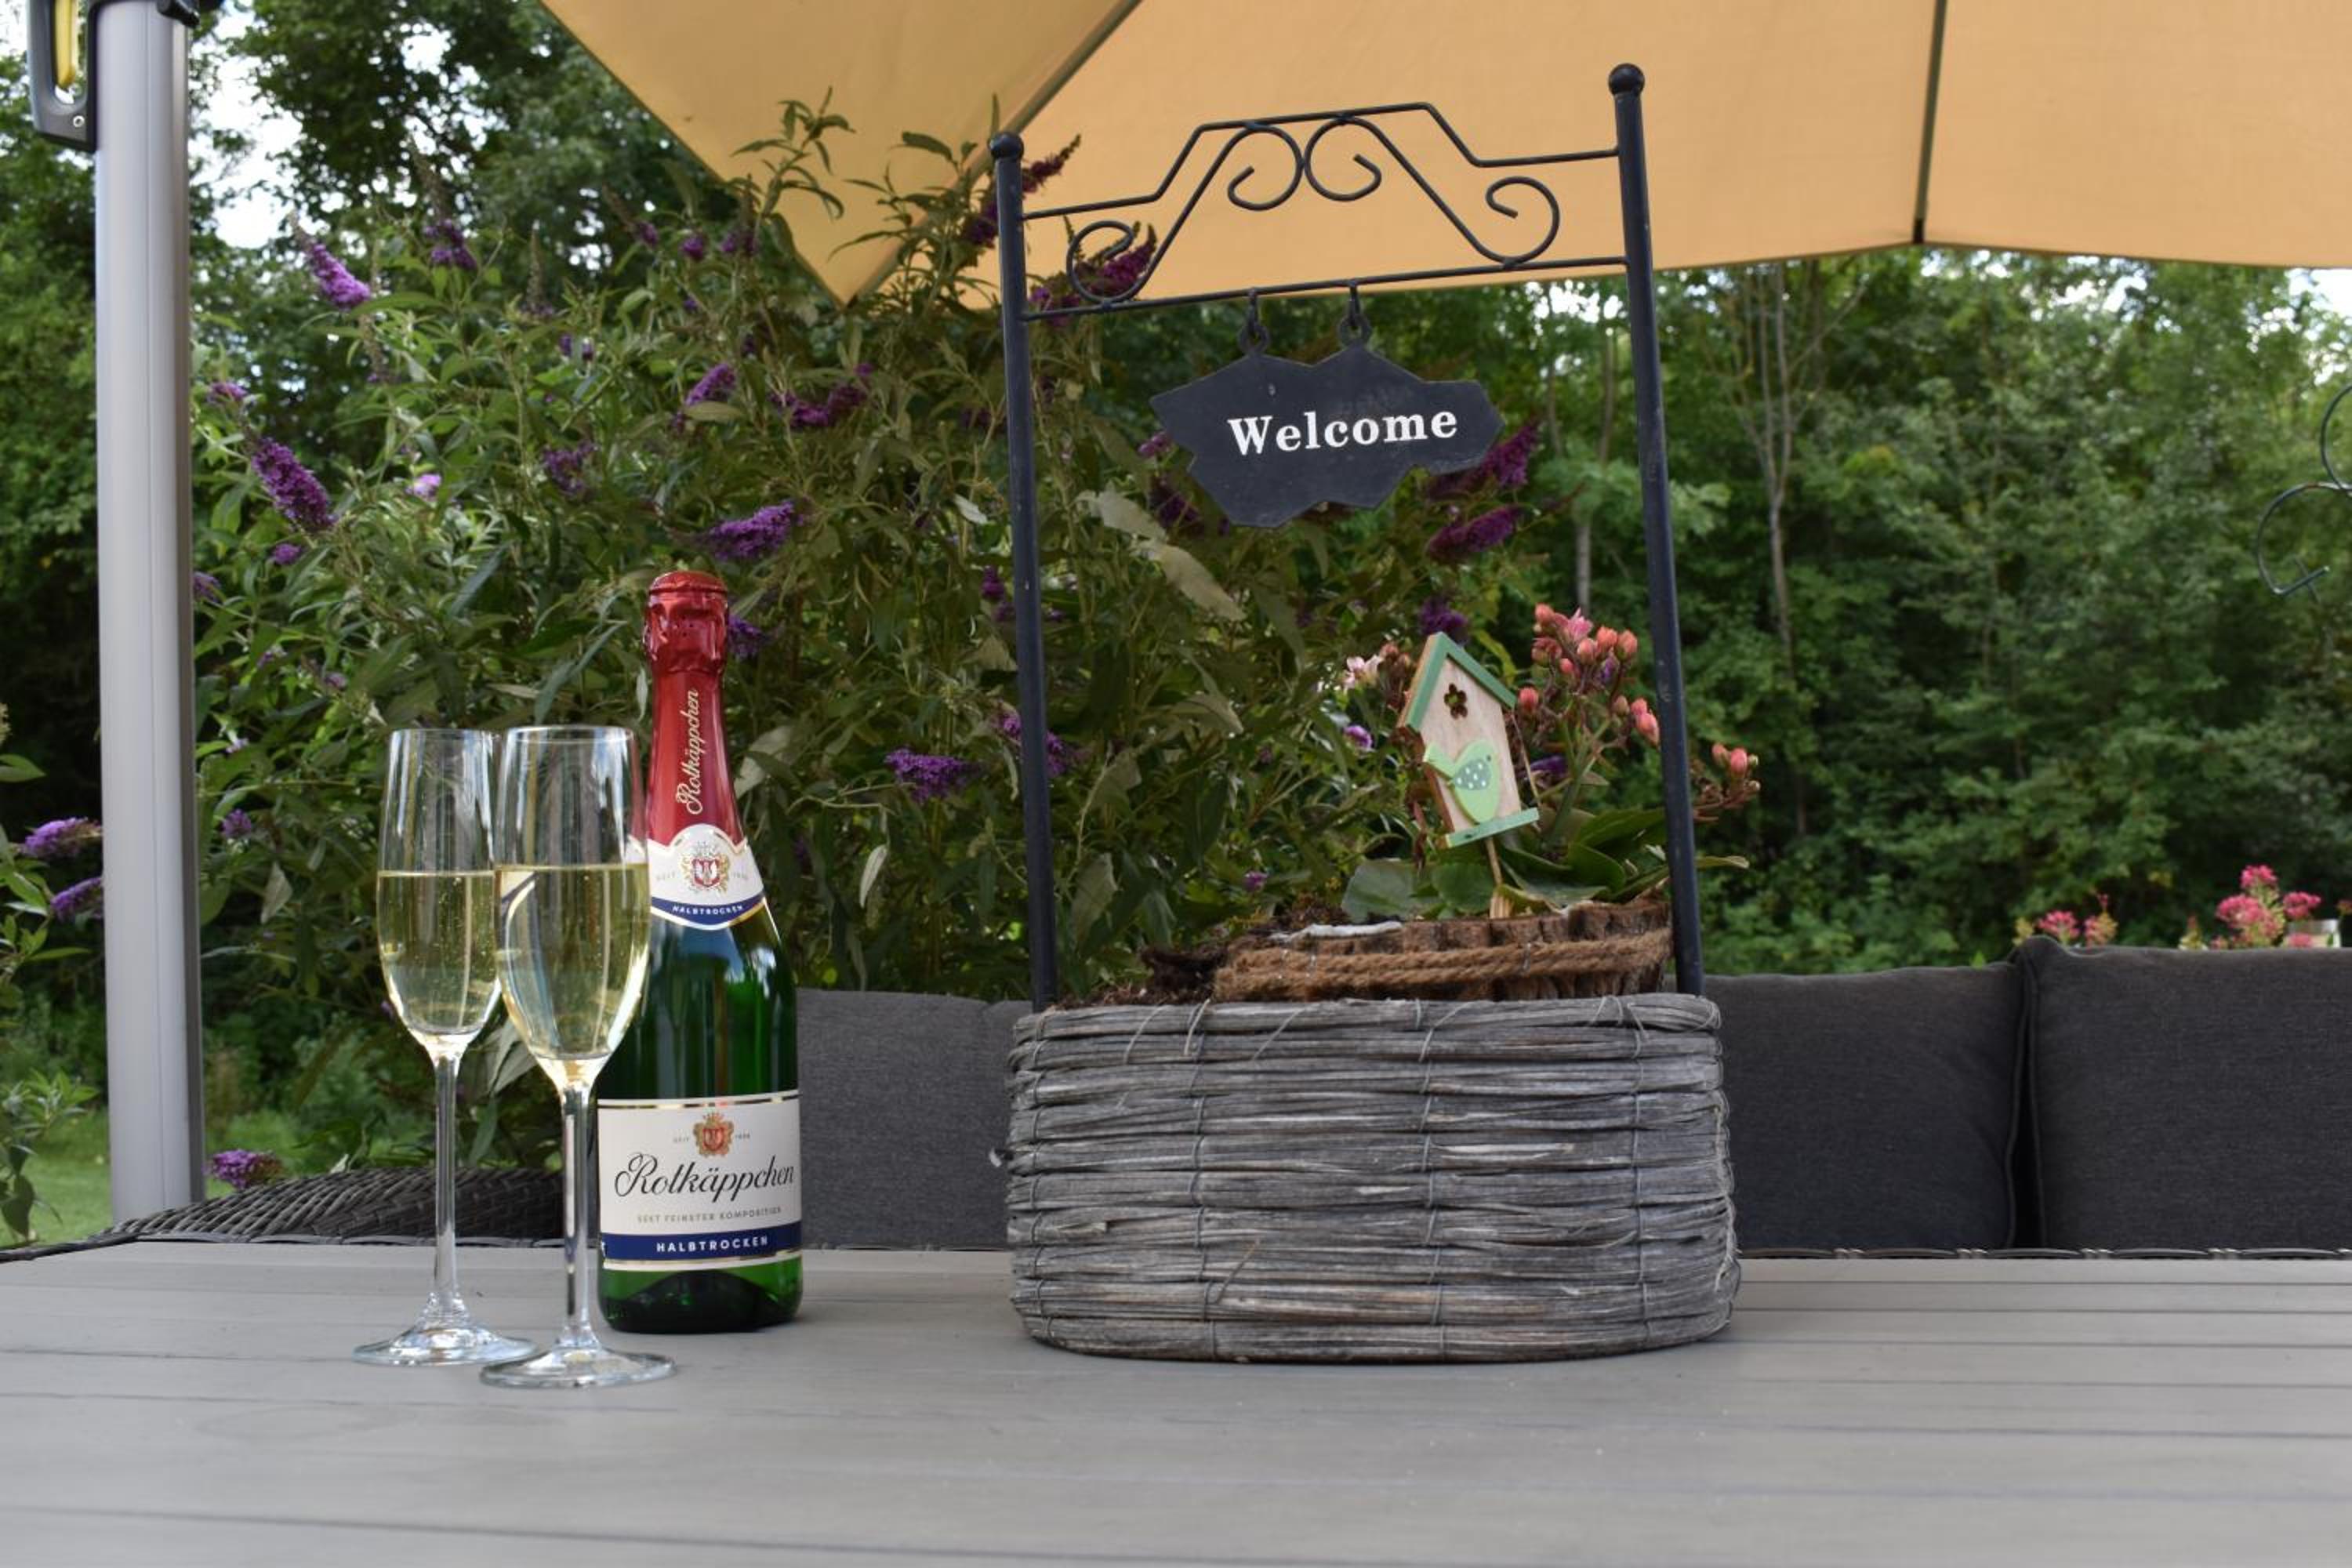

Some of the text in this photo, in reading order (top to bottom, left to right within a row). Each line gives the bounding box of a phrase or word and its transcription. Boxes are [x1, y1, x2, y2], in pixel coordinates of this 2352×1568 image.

[1227, 410, 1458, 456] Welcome
[675, 688, 706, 815] Rotkäppchen
[615, 1152, 793, 1203] Rotkäppchen
[656, 1236, 768, 1253] HALBTROCKEN
